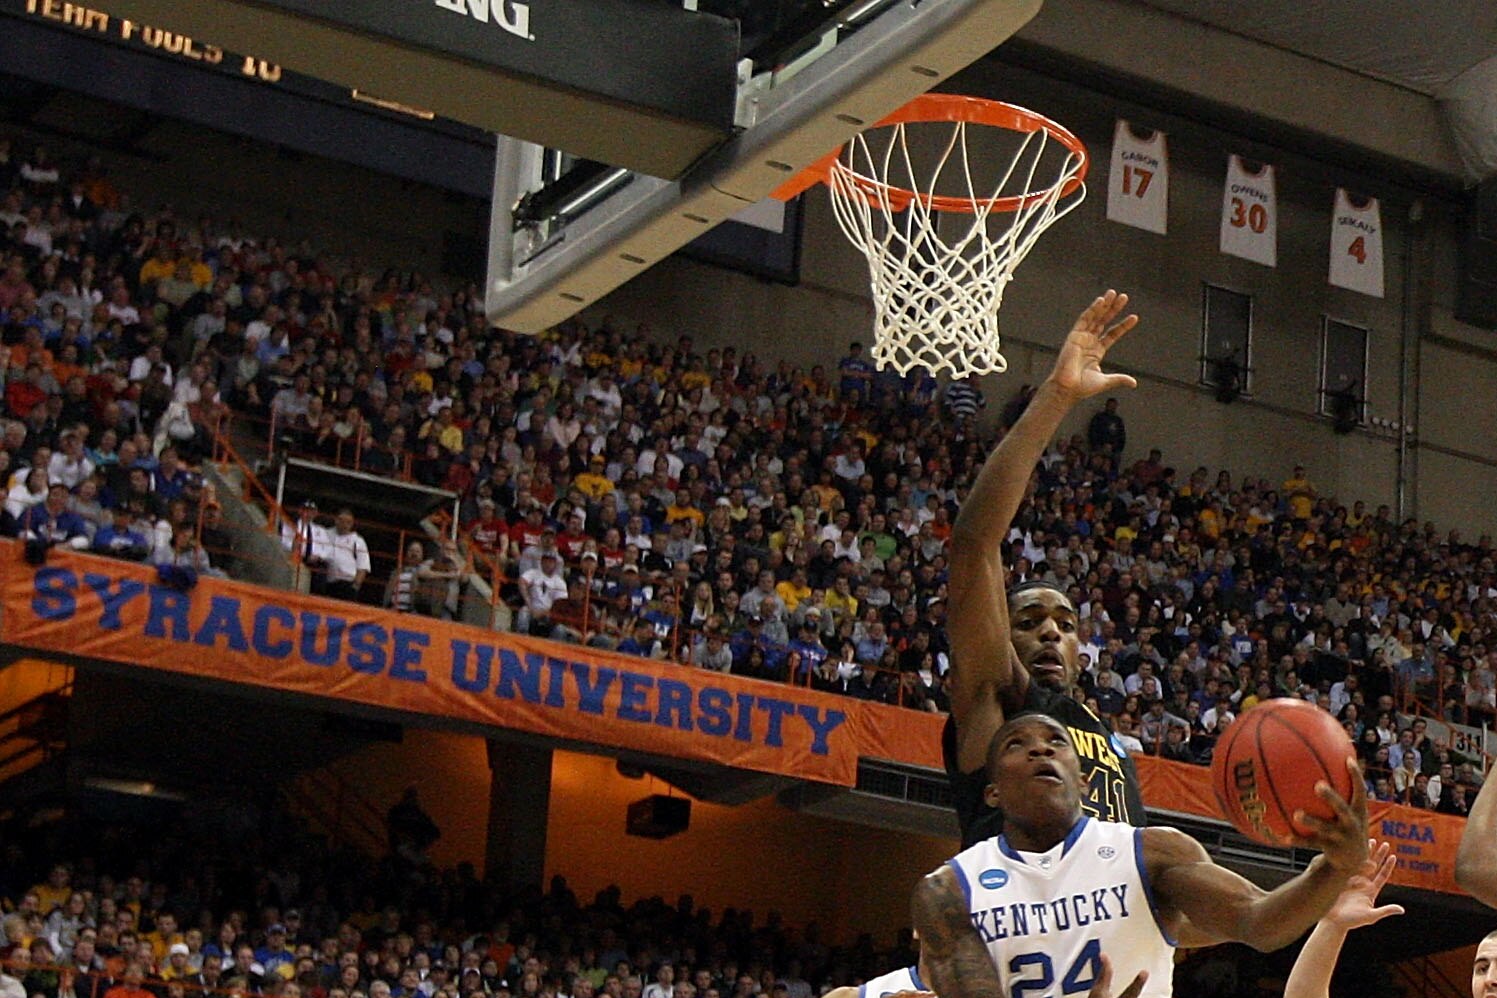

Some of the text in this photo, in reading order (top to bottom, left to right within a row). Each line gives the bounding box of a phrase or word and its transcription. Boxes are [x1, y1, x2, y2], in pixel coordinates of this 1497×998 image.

[1121, 164, 1154, 199] 17
[1230, 196, 1268, 234] 30
[1347, 235, 1367, 265] 4
[31, 567, 847, 754] SYRACUSE UNIVERSITY
[1079, 765, 1130, 824] 41
[1381, 820, 1436, 844] NCAA
[970, 884, 1129, 943] KENTUCKY
